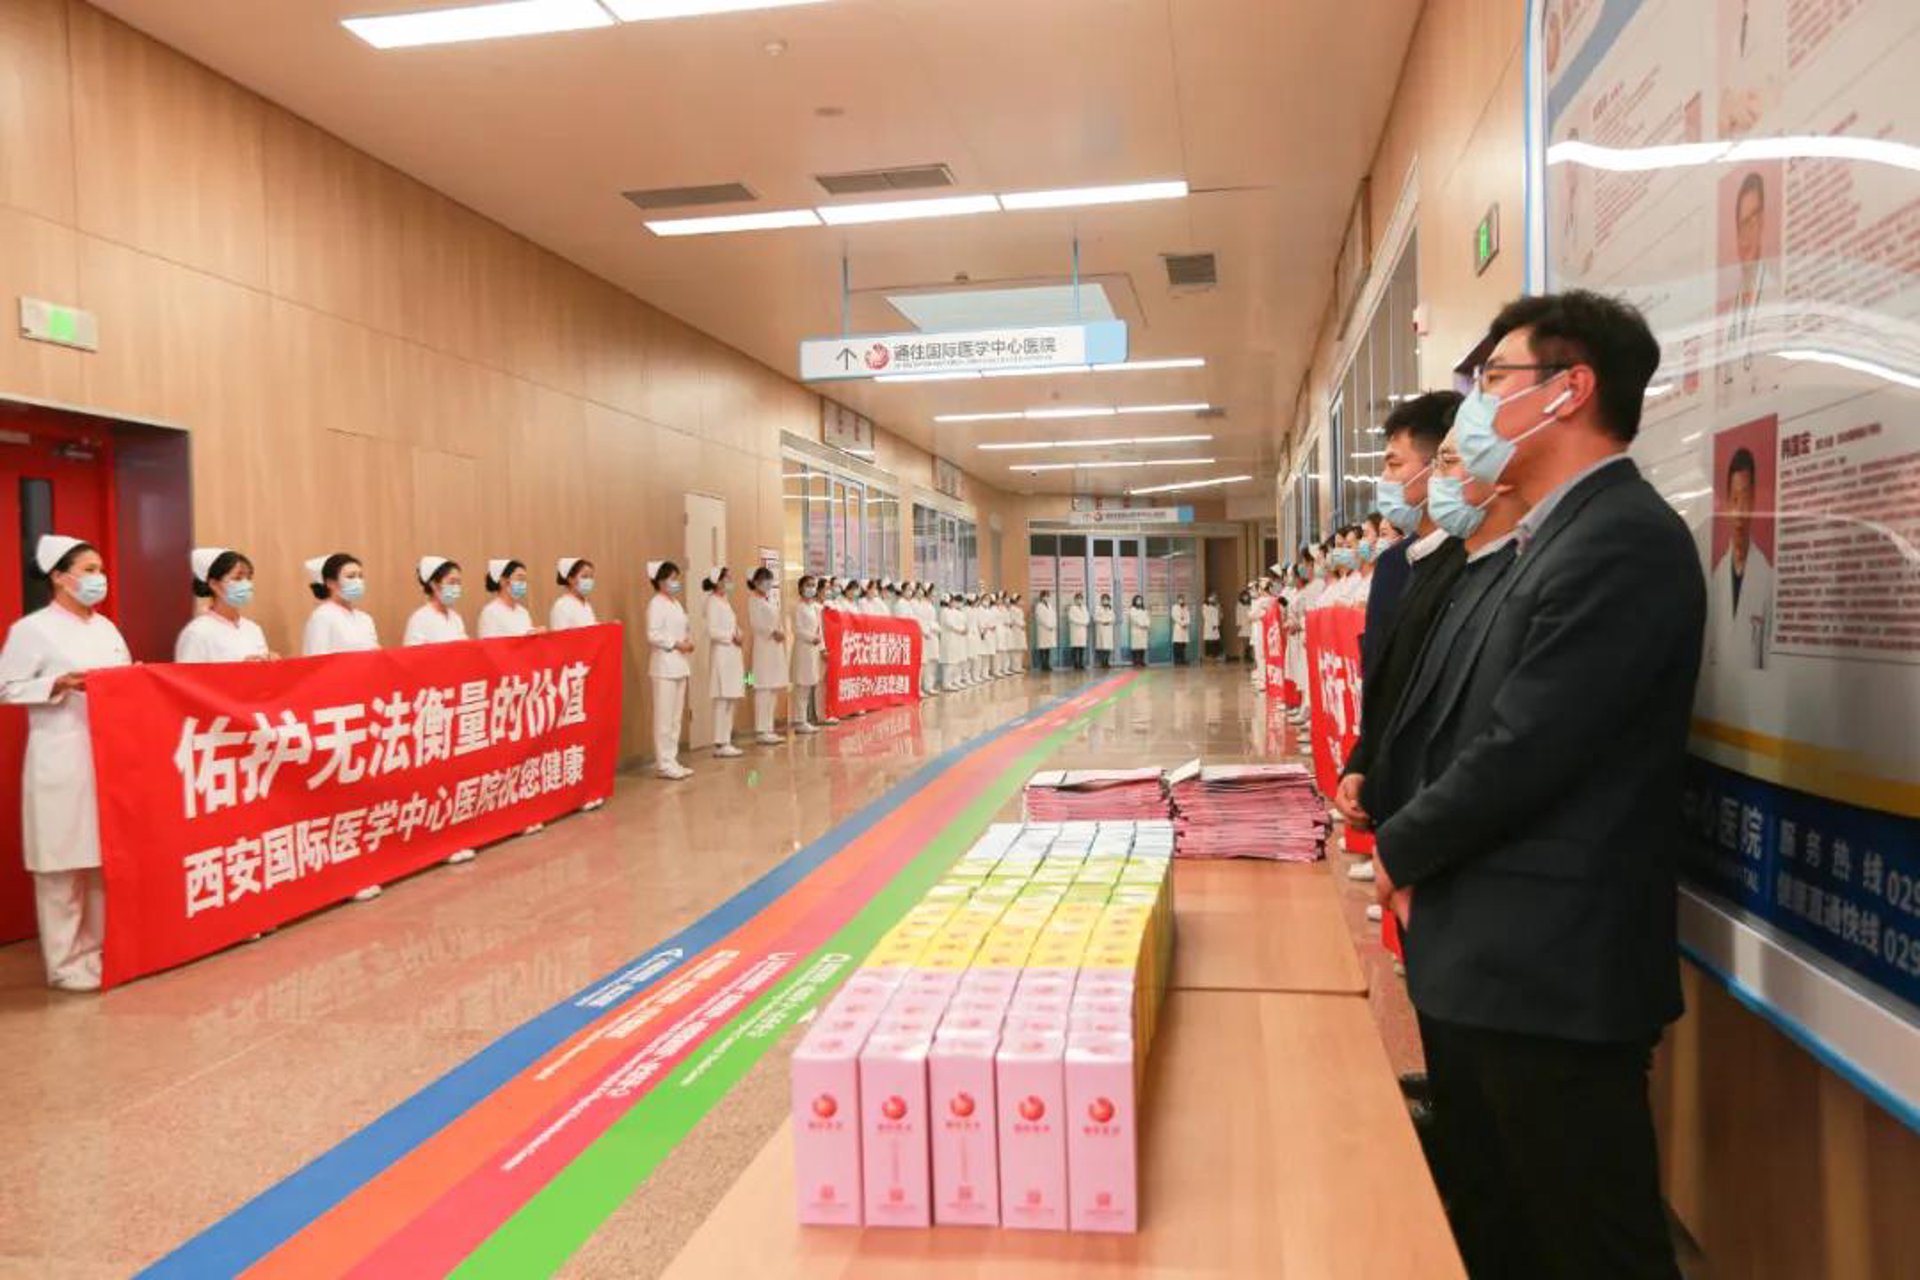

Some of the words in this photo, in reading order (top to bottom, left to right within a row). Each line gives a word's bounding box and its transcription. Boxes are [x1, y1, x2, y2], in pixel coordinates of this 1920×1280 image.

[894, 337, 1057, 361] 通往国际医学中心医院
[174, 661, 589, 818] 佑护无法衡量的价值
[184, 745, 586, 917] 西安国际医学中心医院祝您健康
